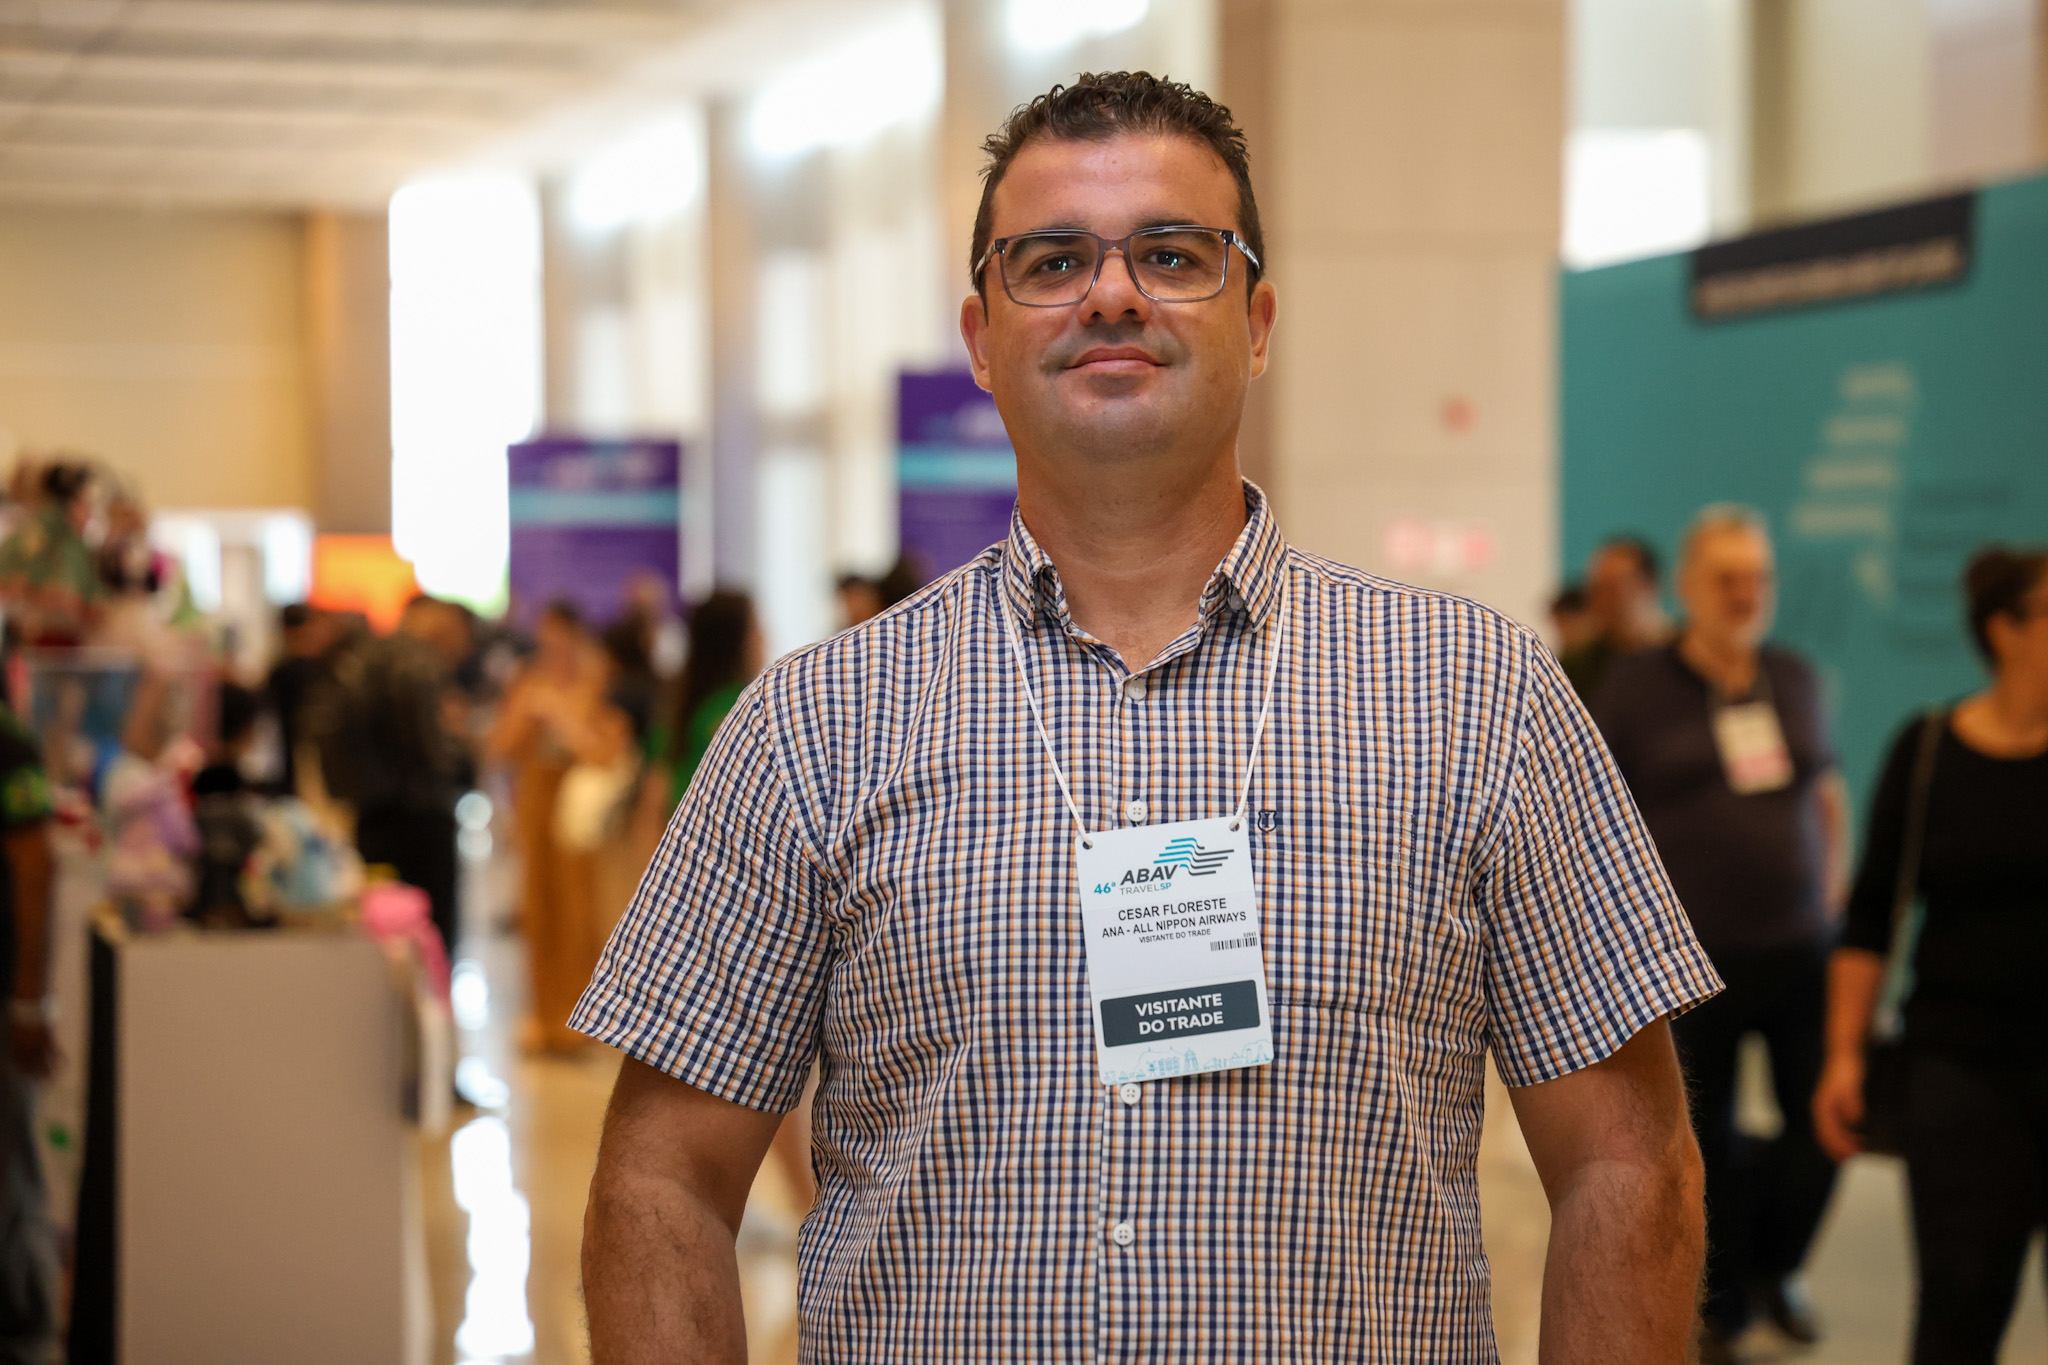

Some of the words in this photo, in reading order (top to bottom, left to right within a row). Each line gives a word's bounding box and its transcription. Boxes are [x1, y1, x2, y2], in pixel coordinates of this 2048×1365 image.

[1120, 864, 1178, 886] ABAV
[1118, 905, 1160, 921] CESAR
[1163, 898, 1227, 916] FLORESTE
[1102, 926, 1125, 939] ANA
[1133, 922, 1153, 935] ALL
[1156, 917, 1196, 932] NIPPON
[1199, 911, 1247, 926] AIRWAYS
[1139, 932, 1175, 944] VISITANTE
[1175, 931, 1186, 939] DO
[1186, 928, 1211, 938] TRADE
[1135, 993, 1223, 1017] VISITANTE
[1138, 1019, 1165, 1035] DO
[1167, 1011, 1224, 1031] TRADE
